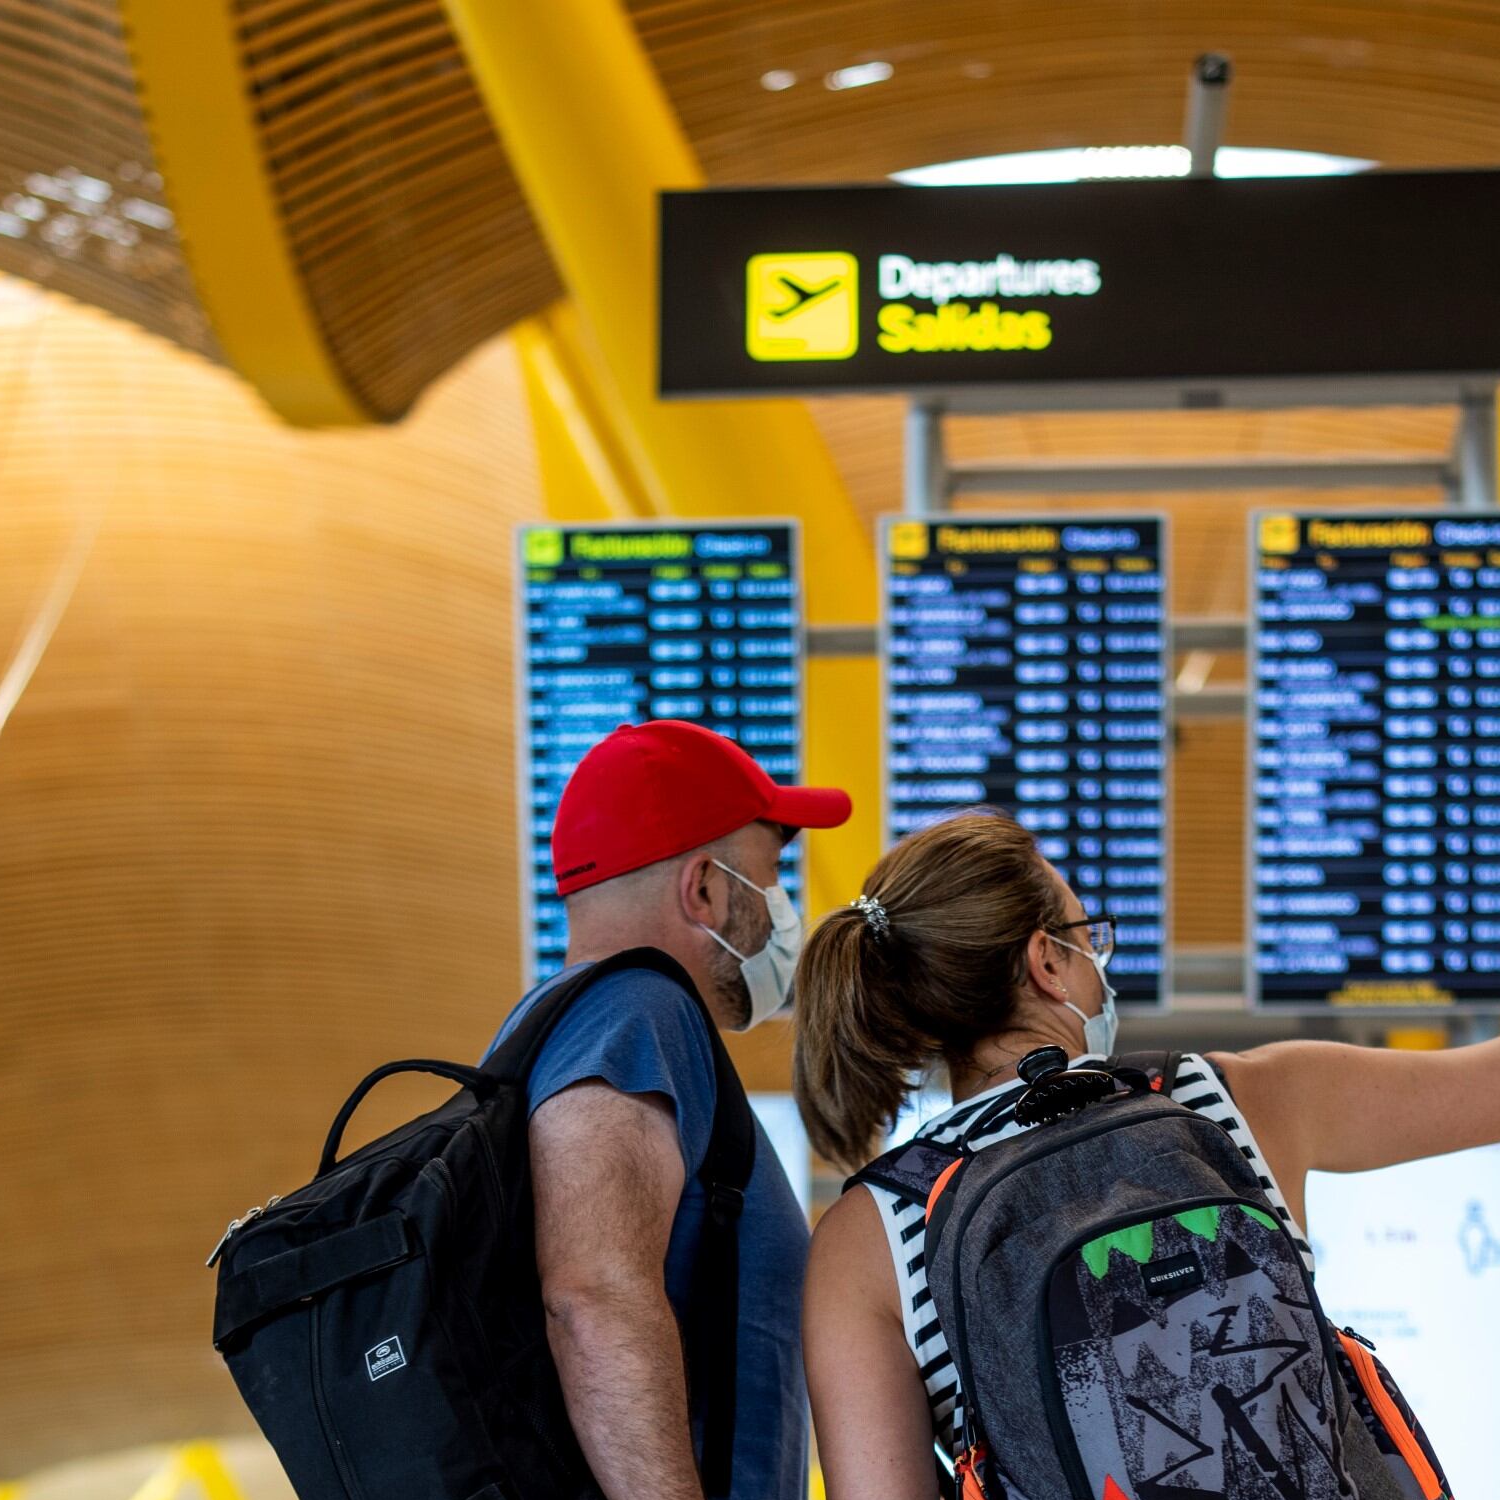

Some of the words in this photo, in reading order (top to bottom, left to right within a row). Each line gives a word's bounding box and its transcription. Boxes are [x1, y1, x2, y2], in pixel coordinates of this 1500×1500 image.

[878, 253, 1101, 305] Departures
[877, 302, 1052, 353] Salidas
[1150, 1266, 1195, 1283] QUIKSILVER
